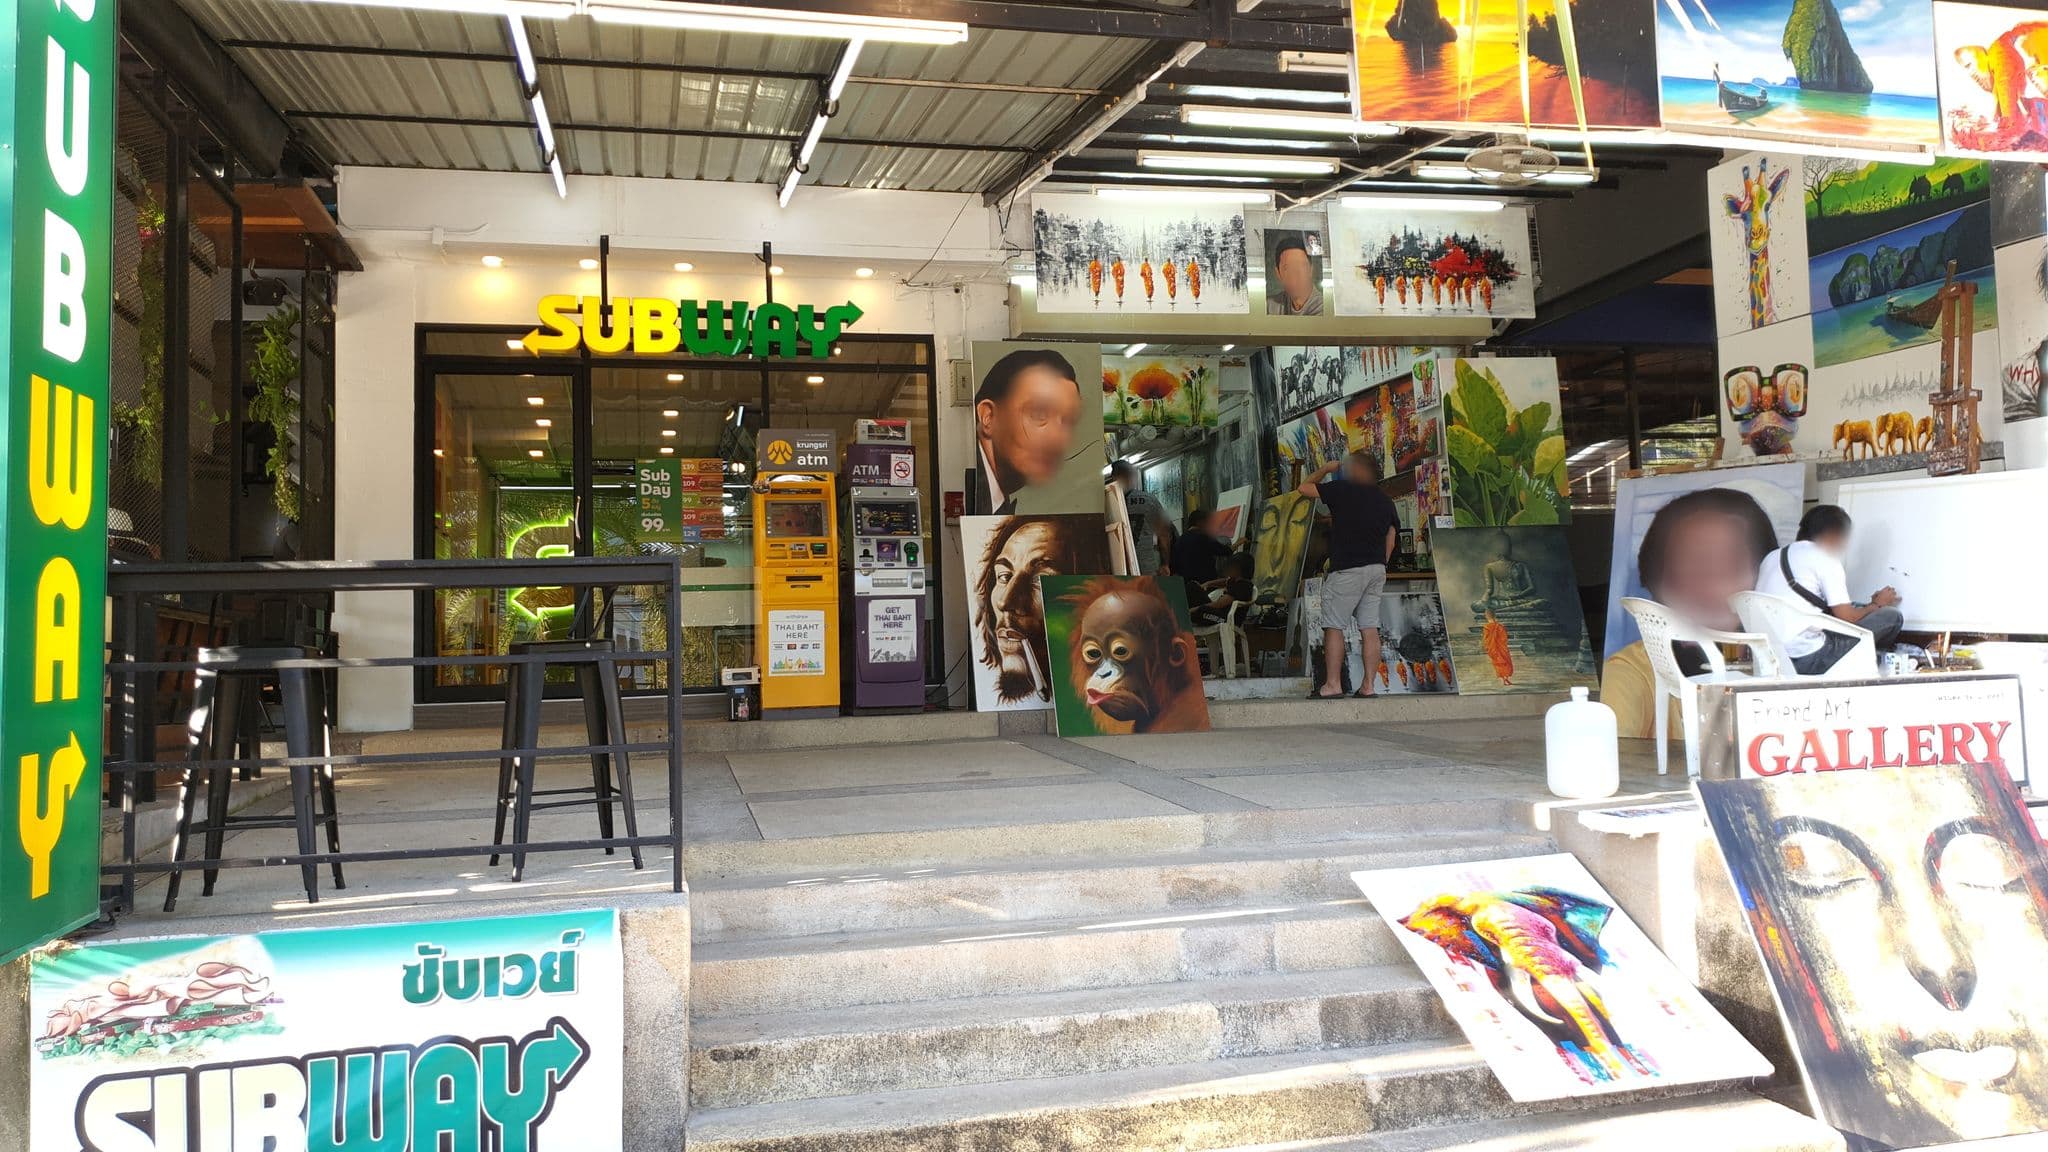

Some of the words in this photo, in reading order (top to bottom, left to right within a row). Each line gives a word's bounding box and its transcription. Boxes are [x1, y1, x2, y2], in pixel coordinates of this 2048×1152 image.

[522, 294, 865, 359] SUBWAY
[796, 441, 828, 449] krungsri
[797, 453, 828, 466] atm
[640, 469, 670, 481] Sub
[852, 464, 880, 476] ATM
[641, 483, 671, 498] Day
[642, 498, 651, 510] 5
[641, 518, 664, 532] 99
[786, 631, 809, 639] HERE
[1747, 720, 2013, 777] GALLERY
[402, 929, 588, 1005] ซับเวย์
